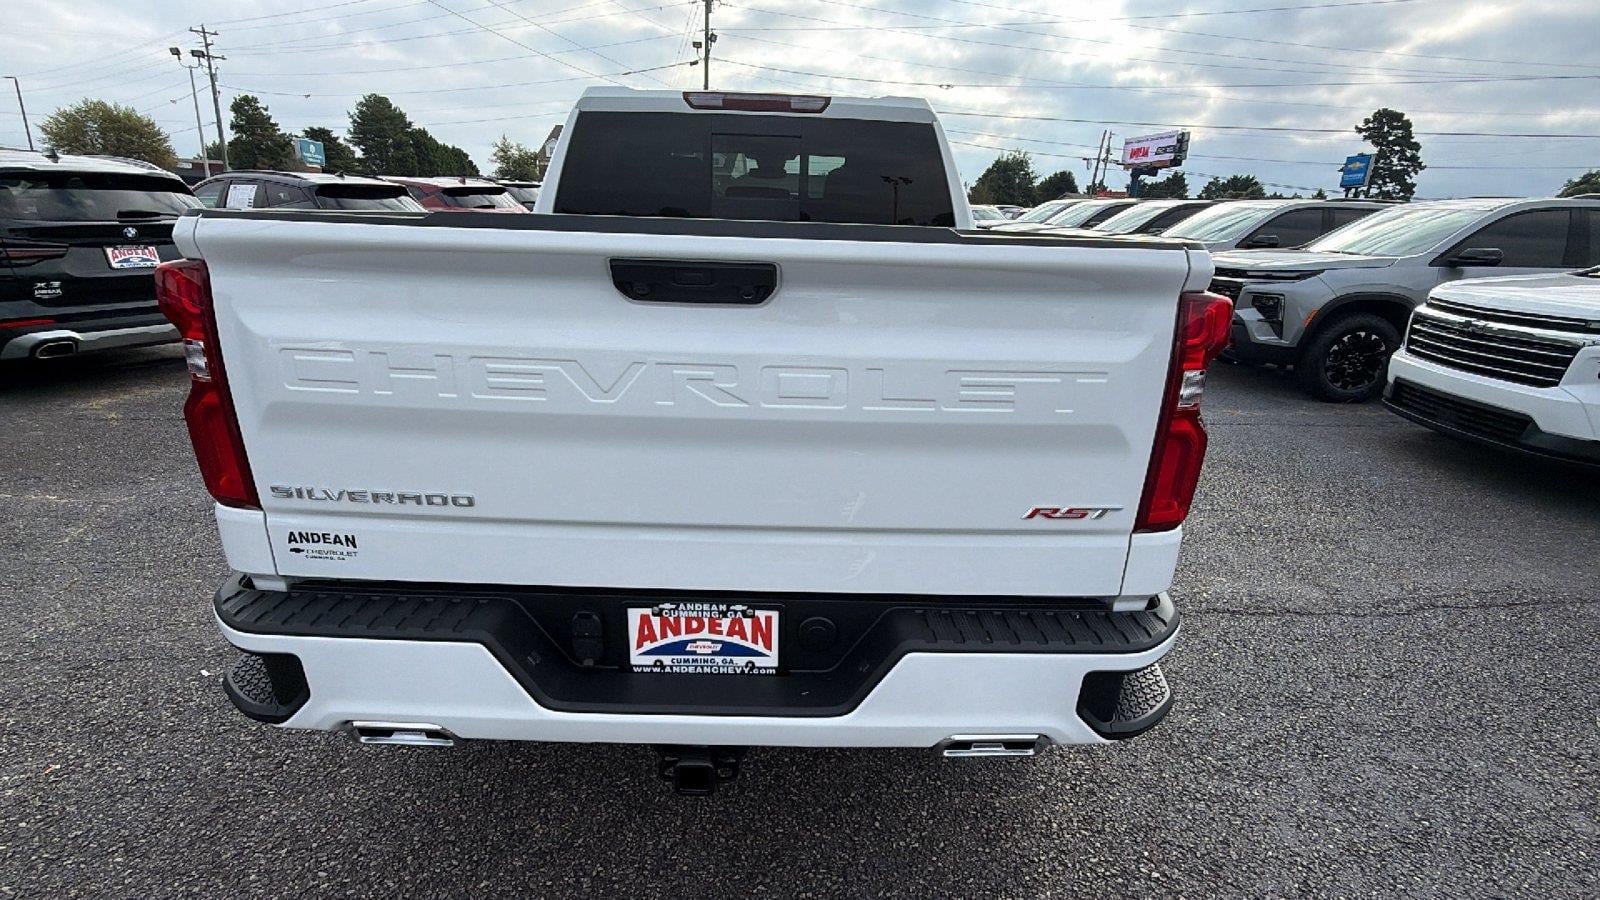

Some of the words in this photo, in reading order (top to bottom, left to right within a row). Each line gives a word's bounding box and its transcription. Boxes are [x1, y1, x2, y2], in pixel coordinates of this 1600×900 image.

[111, 246, 157, 261] ANDEAN
[33, 281, 62, 289] X3
[278, 346, 1109, 413] CHEVROLET
[269, 485, 477, 508] SILVERADO
[1021, 506, 1125, 520] RST
[287, 531, 358, 549] ANDEAN
[306, 548, 359, 557] CHEVROLET
[662, 610, 722, 618] CUMMING,
[677, 603, 727, 611] ANDEAN
[636, 614, 772, 652] ANDEAN
[633, 666, 776, 674] www.ANDEANCHEVY.com
